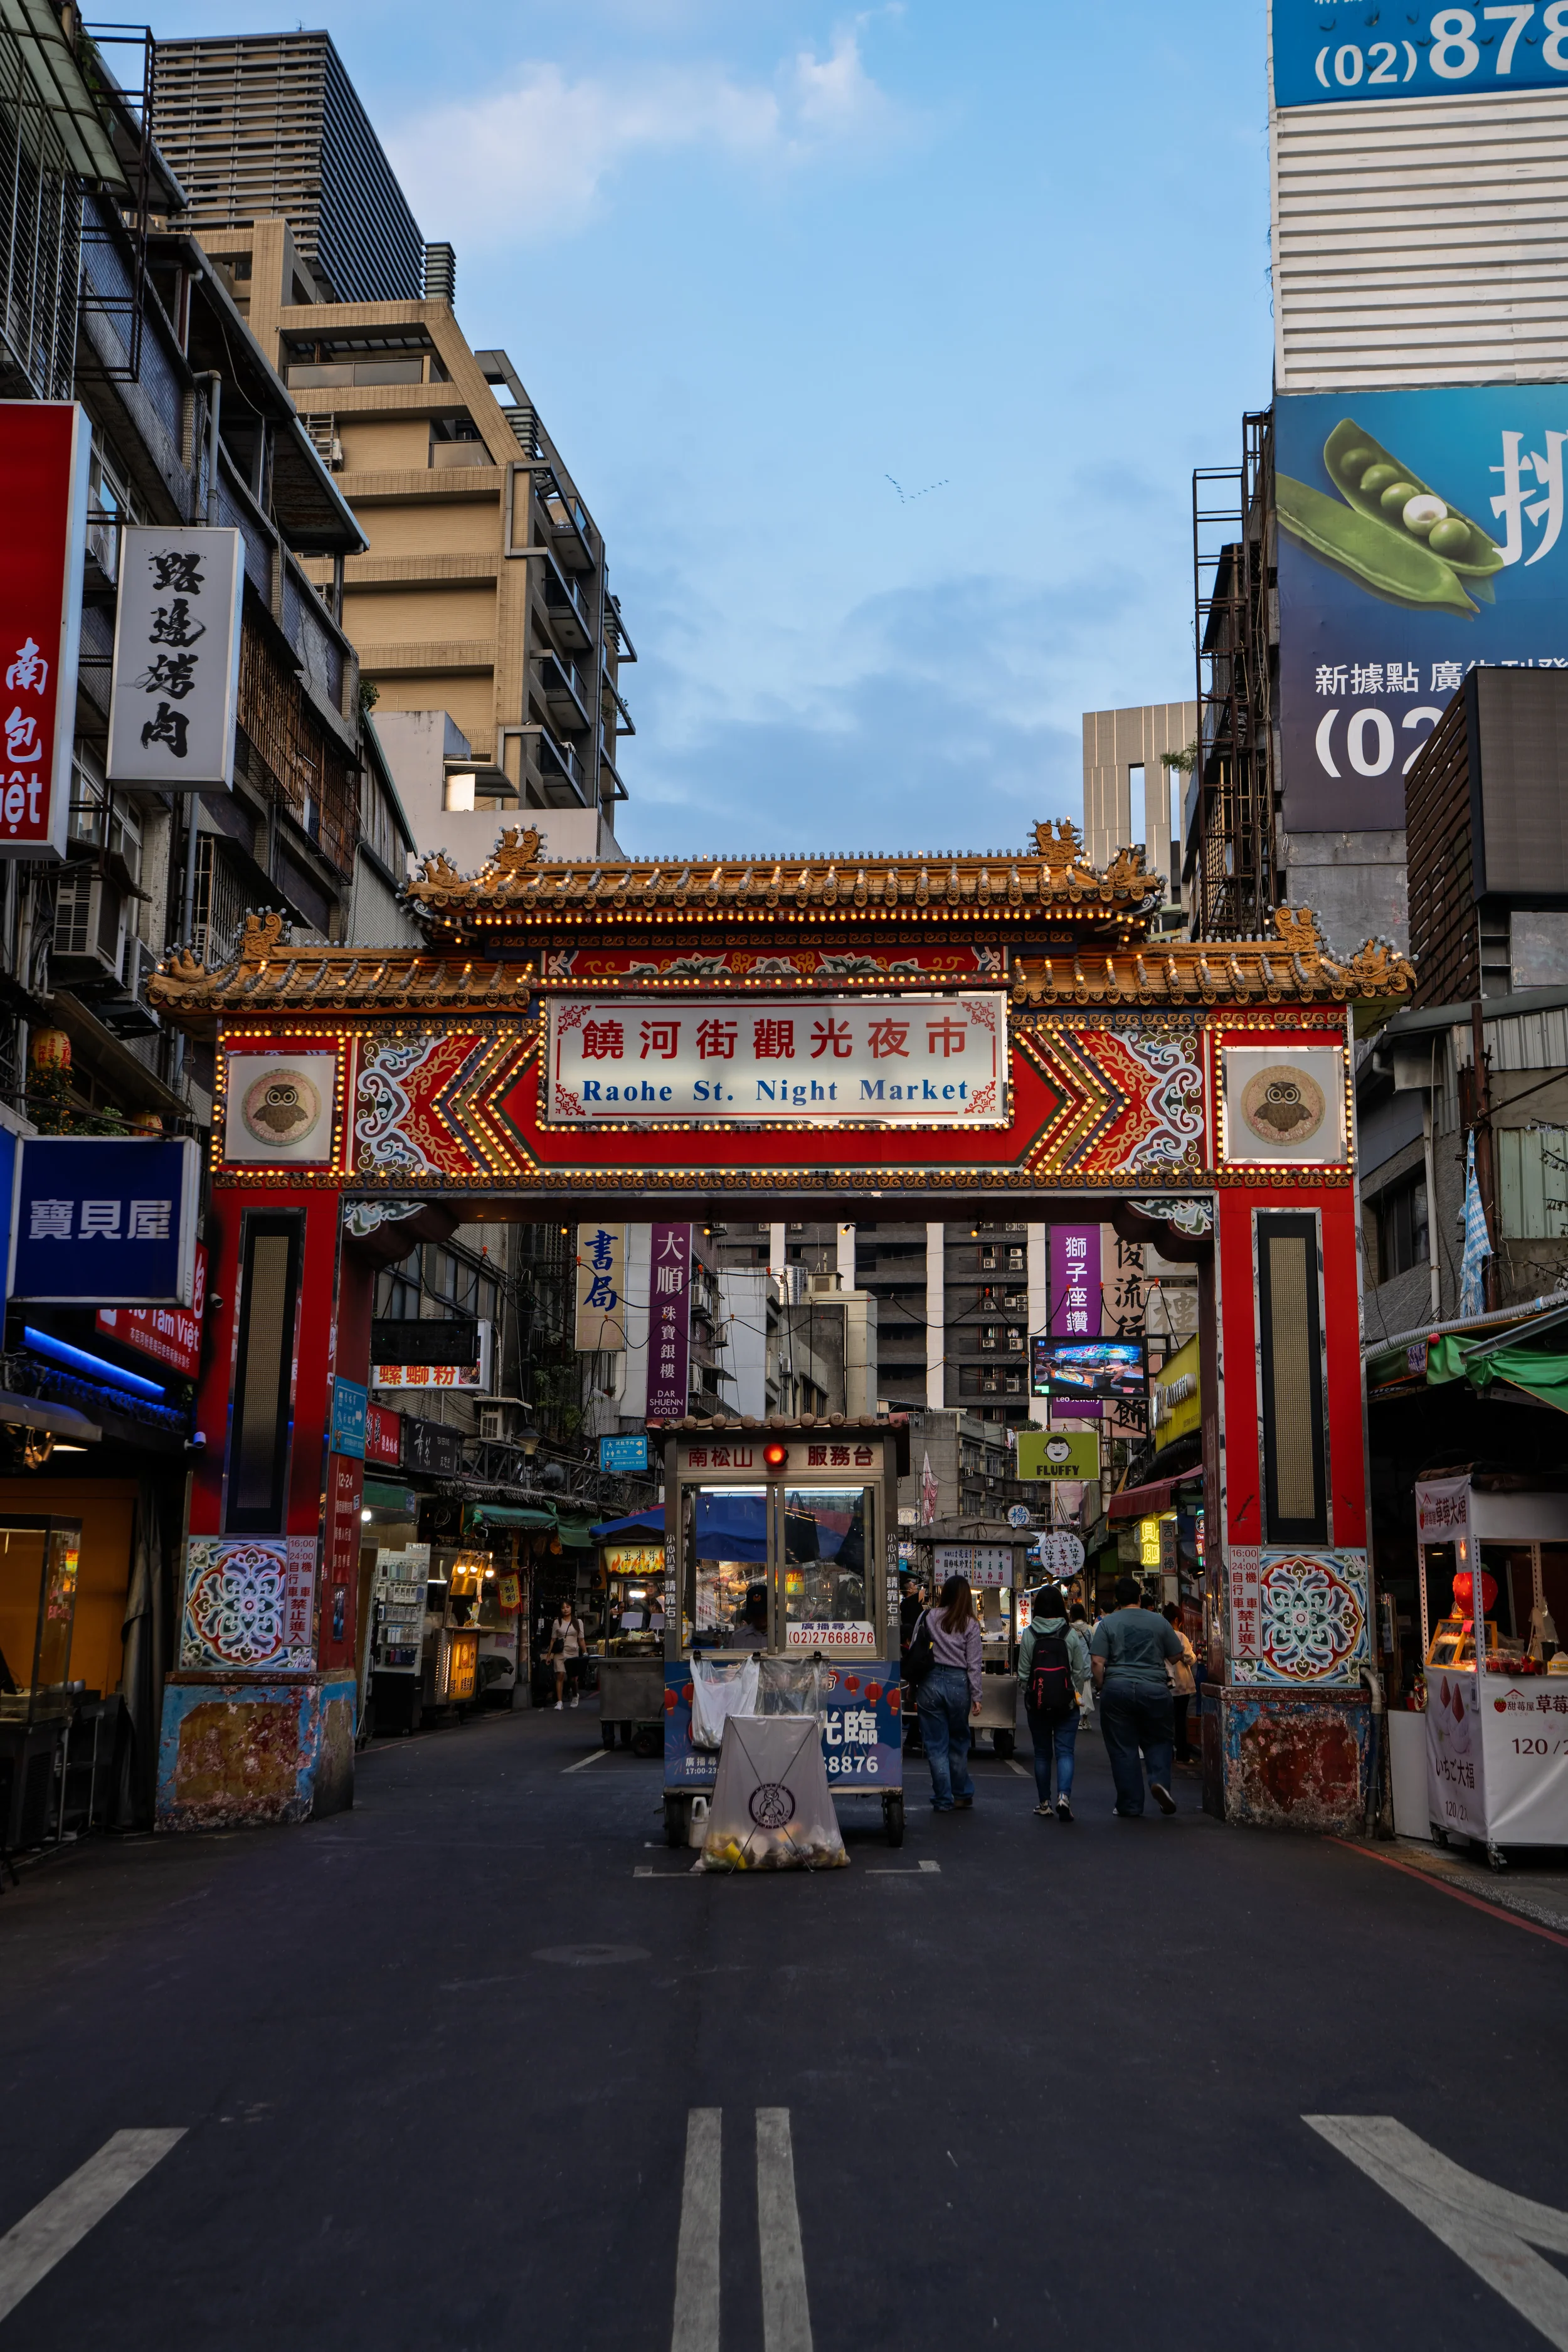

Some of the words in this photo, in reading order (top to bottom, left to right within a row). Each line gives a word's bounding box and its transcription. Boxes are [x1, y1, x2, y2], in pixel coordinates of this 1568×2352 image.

[1315, 661, 1419, 696] 新據點
[581, 1016, 968, 1060] 饒河街觀光夜市
[582, 1080, 673, 1101] Raohe
[693, 1080, 733, 1101] St.
[756, 1079, 838, 1106] Night
[859, 1079, 968, 1101] Market
[29, 1199, 172, 1240] 寶貝屋
[583, 1229, 618, 1312] 書局
[1066, 1237, 1088, 1333] 獅子座鑽
[649, 1398, 684, 1406] SHUENN
[654, 1407, 678, 1415] GOLD
[689, 1446, 753, 1467] 南松山
[808, 1445, 874, 1466] 服務台
[1036, 1465, 1079, 1476] FLUFFY
[1011, 1507, 1027, 1523] 楊
[1436, 1495, 1466, 1527] 草莓大福
[289, 1552, 314, 1560] 24:00
[290, 1540, 314, 1548] 16:00
[624, 1549, 658, 1562] 玉米哥
[665, 1534, 676, 1574] 小心扒手
[887, 1533, 897, 1573] 小心扒手
[1058, 1549, 1069, 1567] 古早味
[1163, 1524, 1175, 1569] 吉拿棒
[1231, 1549, 1257, 1557] 16:00
[288, 1562, 299, 1597] 自行車
[300, 1561, 312, 1597] 機車
[1232, 1562, 1257, 1571] 24:00
[665, 1579, 677, 1631] 請靠右走
[886, 1576, 899, 1628] 請靠右走
[1232, 1572, 1244, 1609] 自行車
[1245, 1572, 1258, 1609] 機車
[289, 1599, 307, 1643] 禁止進入
[802, 1622, 860, 1631] 廣播尋人
[1019, 1599, 1030, 1627] 仙草茶
[788, 1631, 874, 1644] (02)27668876
[1237, 1610, 1256, 1656] 禁止進入
[1507, 1701, 1535, 1712] 甜莓屋
[1436, 1756, 1475, 1789] いちご大福
